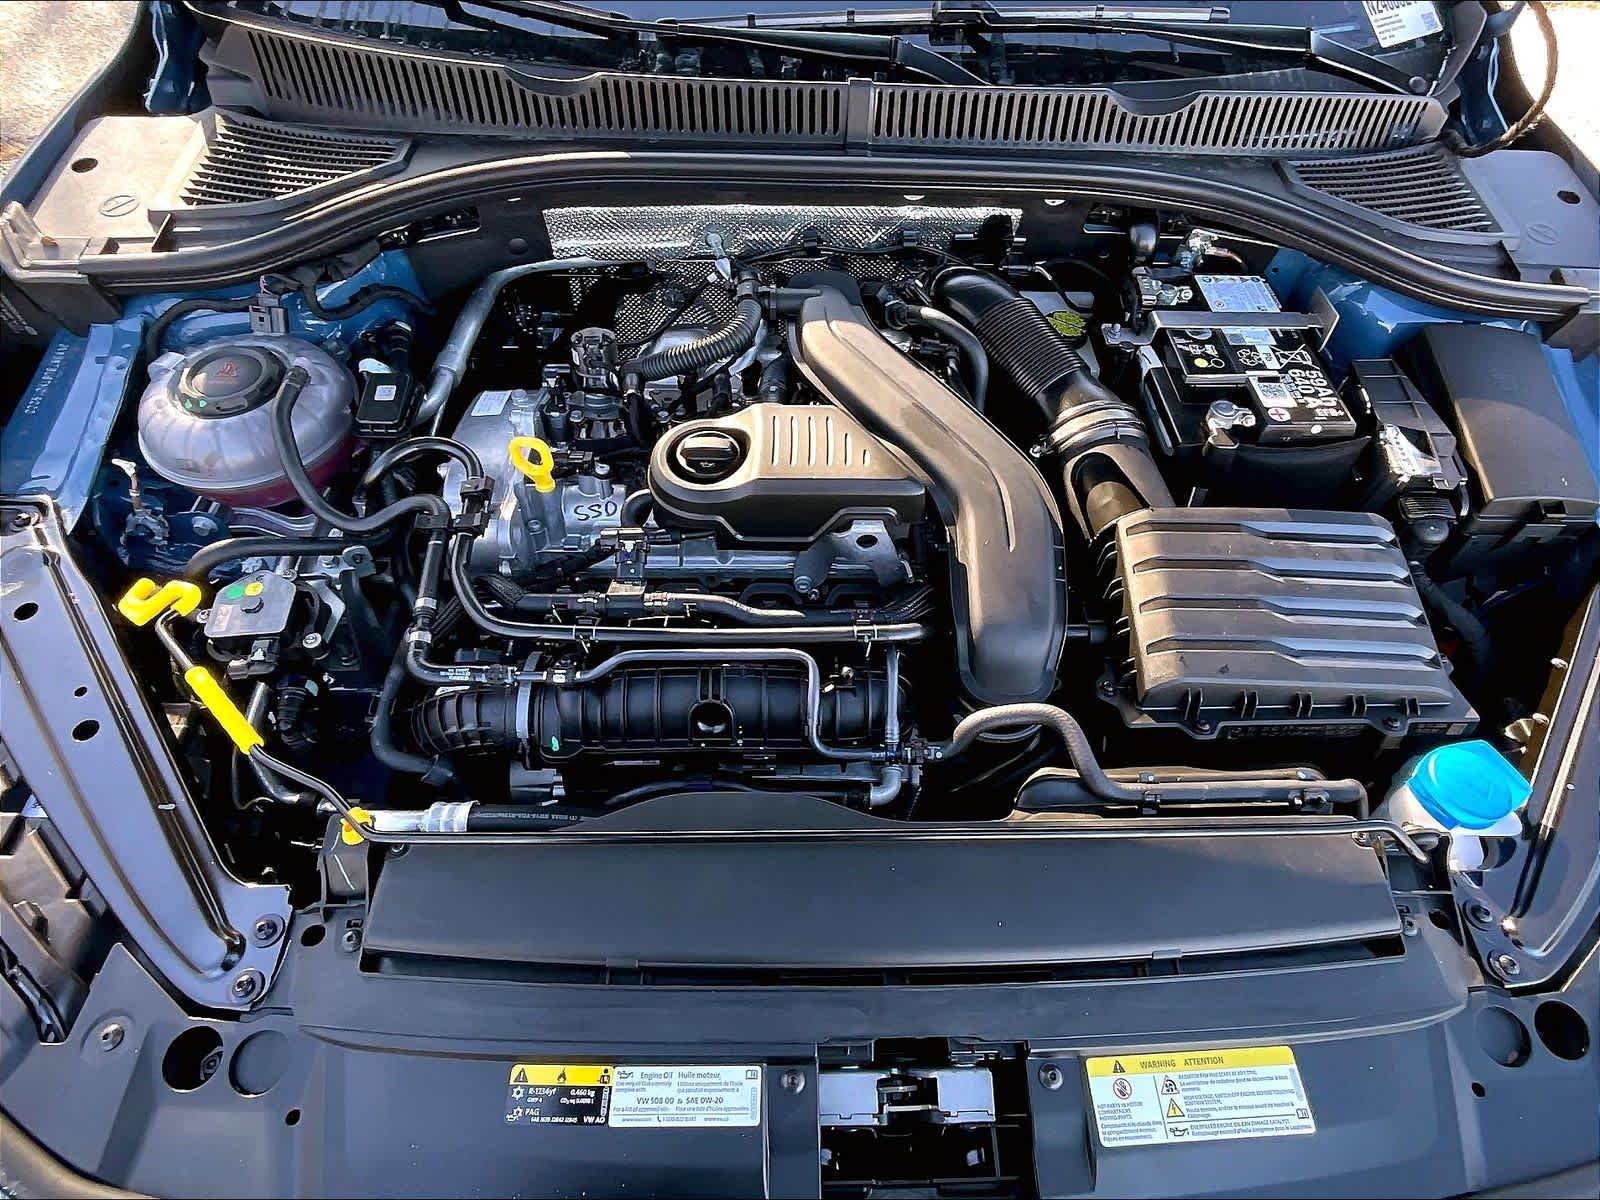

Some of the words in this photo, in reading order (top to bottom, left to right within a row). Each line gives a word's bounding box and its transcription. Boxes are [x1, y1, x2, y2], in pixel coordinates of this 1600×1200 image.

[1288, 369, 1316, 394] 640
[1139, 1059, 1177, 1069] WARNING
[1183, 1056, 1224, 1066] ATTENTION
[640, 1071, 662, 1081] Engine
[678, 1071, 696, 1079] Huile
[636, 1096, 650, 1105] VW
[686, 1096, 699, 1105] SAE
[583, 1115, 596, 1124] VW
